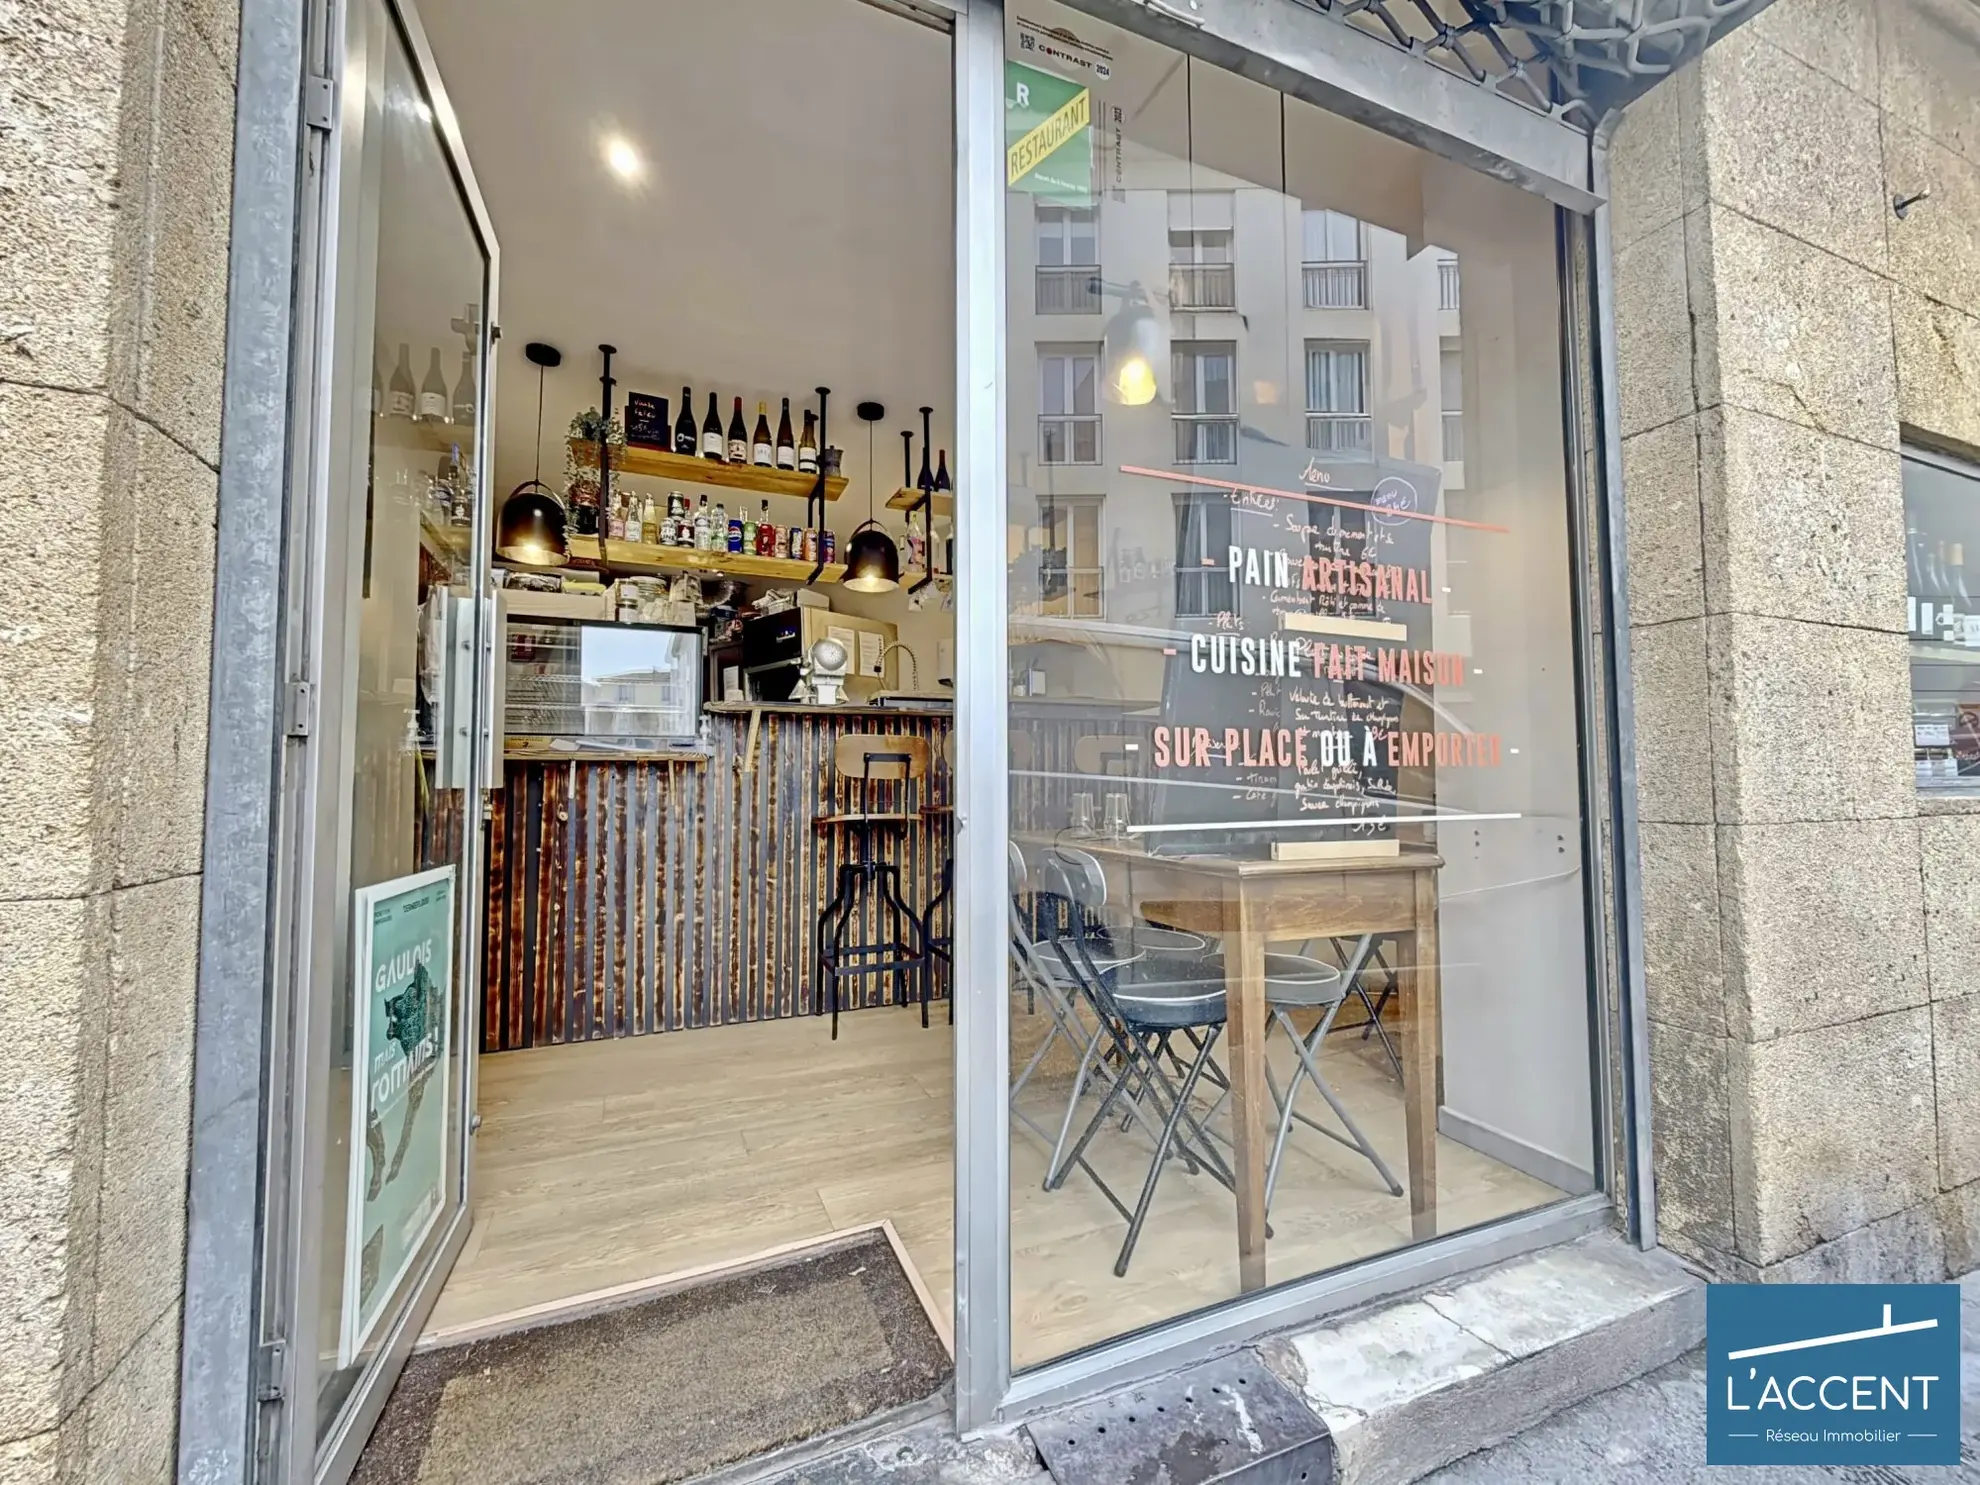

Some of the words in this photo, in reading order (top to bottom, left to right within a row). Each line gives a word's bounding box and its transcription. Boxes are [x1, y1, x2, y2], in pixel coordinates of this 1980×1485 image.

[1016, 82, 1030, 107] R
[1010, 98, 1086, 176] RESTAURANT
[1228, 545, 1289, 588] PAIN
[1302, 555, 1432, 604] ARTISANAL
[1190, 633, 1301, 678] CUISINE
[1313, 642, 1366, 681] FAIT
[1379, 647, 1466, 688] MAISON
[1154, 726, 1212, 768] SUR
[1224, 726, 1308, 768] PLACE
[1320, 730, 1351, 767] OU
[1363, 725, 1377, 766] À
[1388, 730, 1501, 768] EMPORTER
[375, 938, 432, 993] GAULOIS
